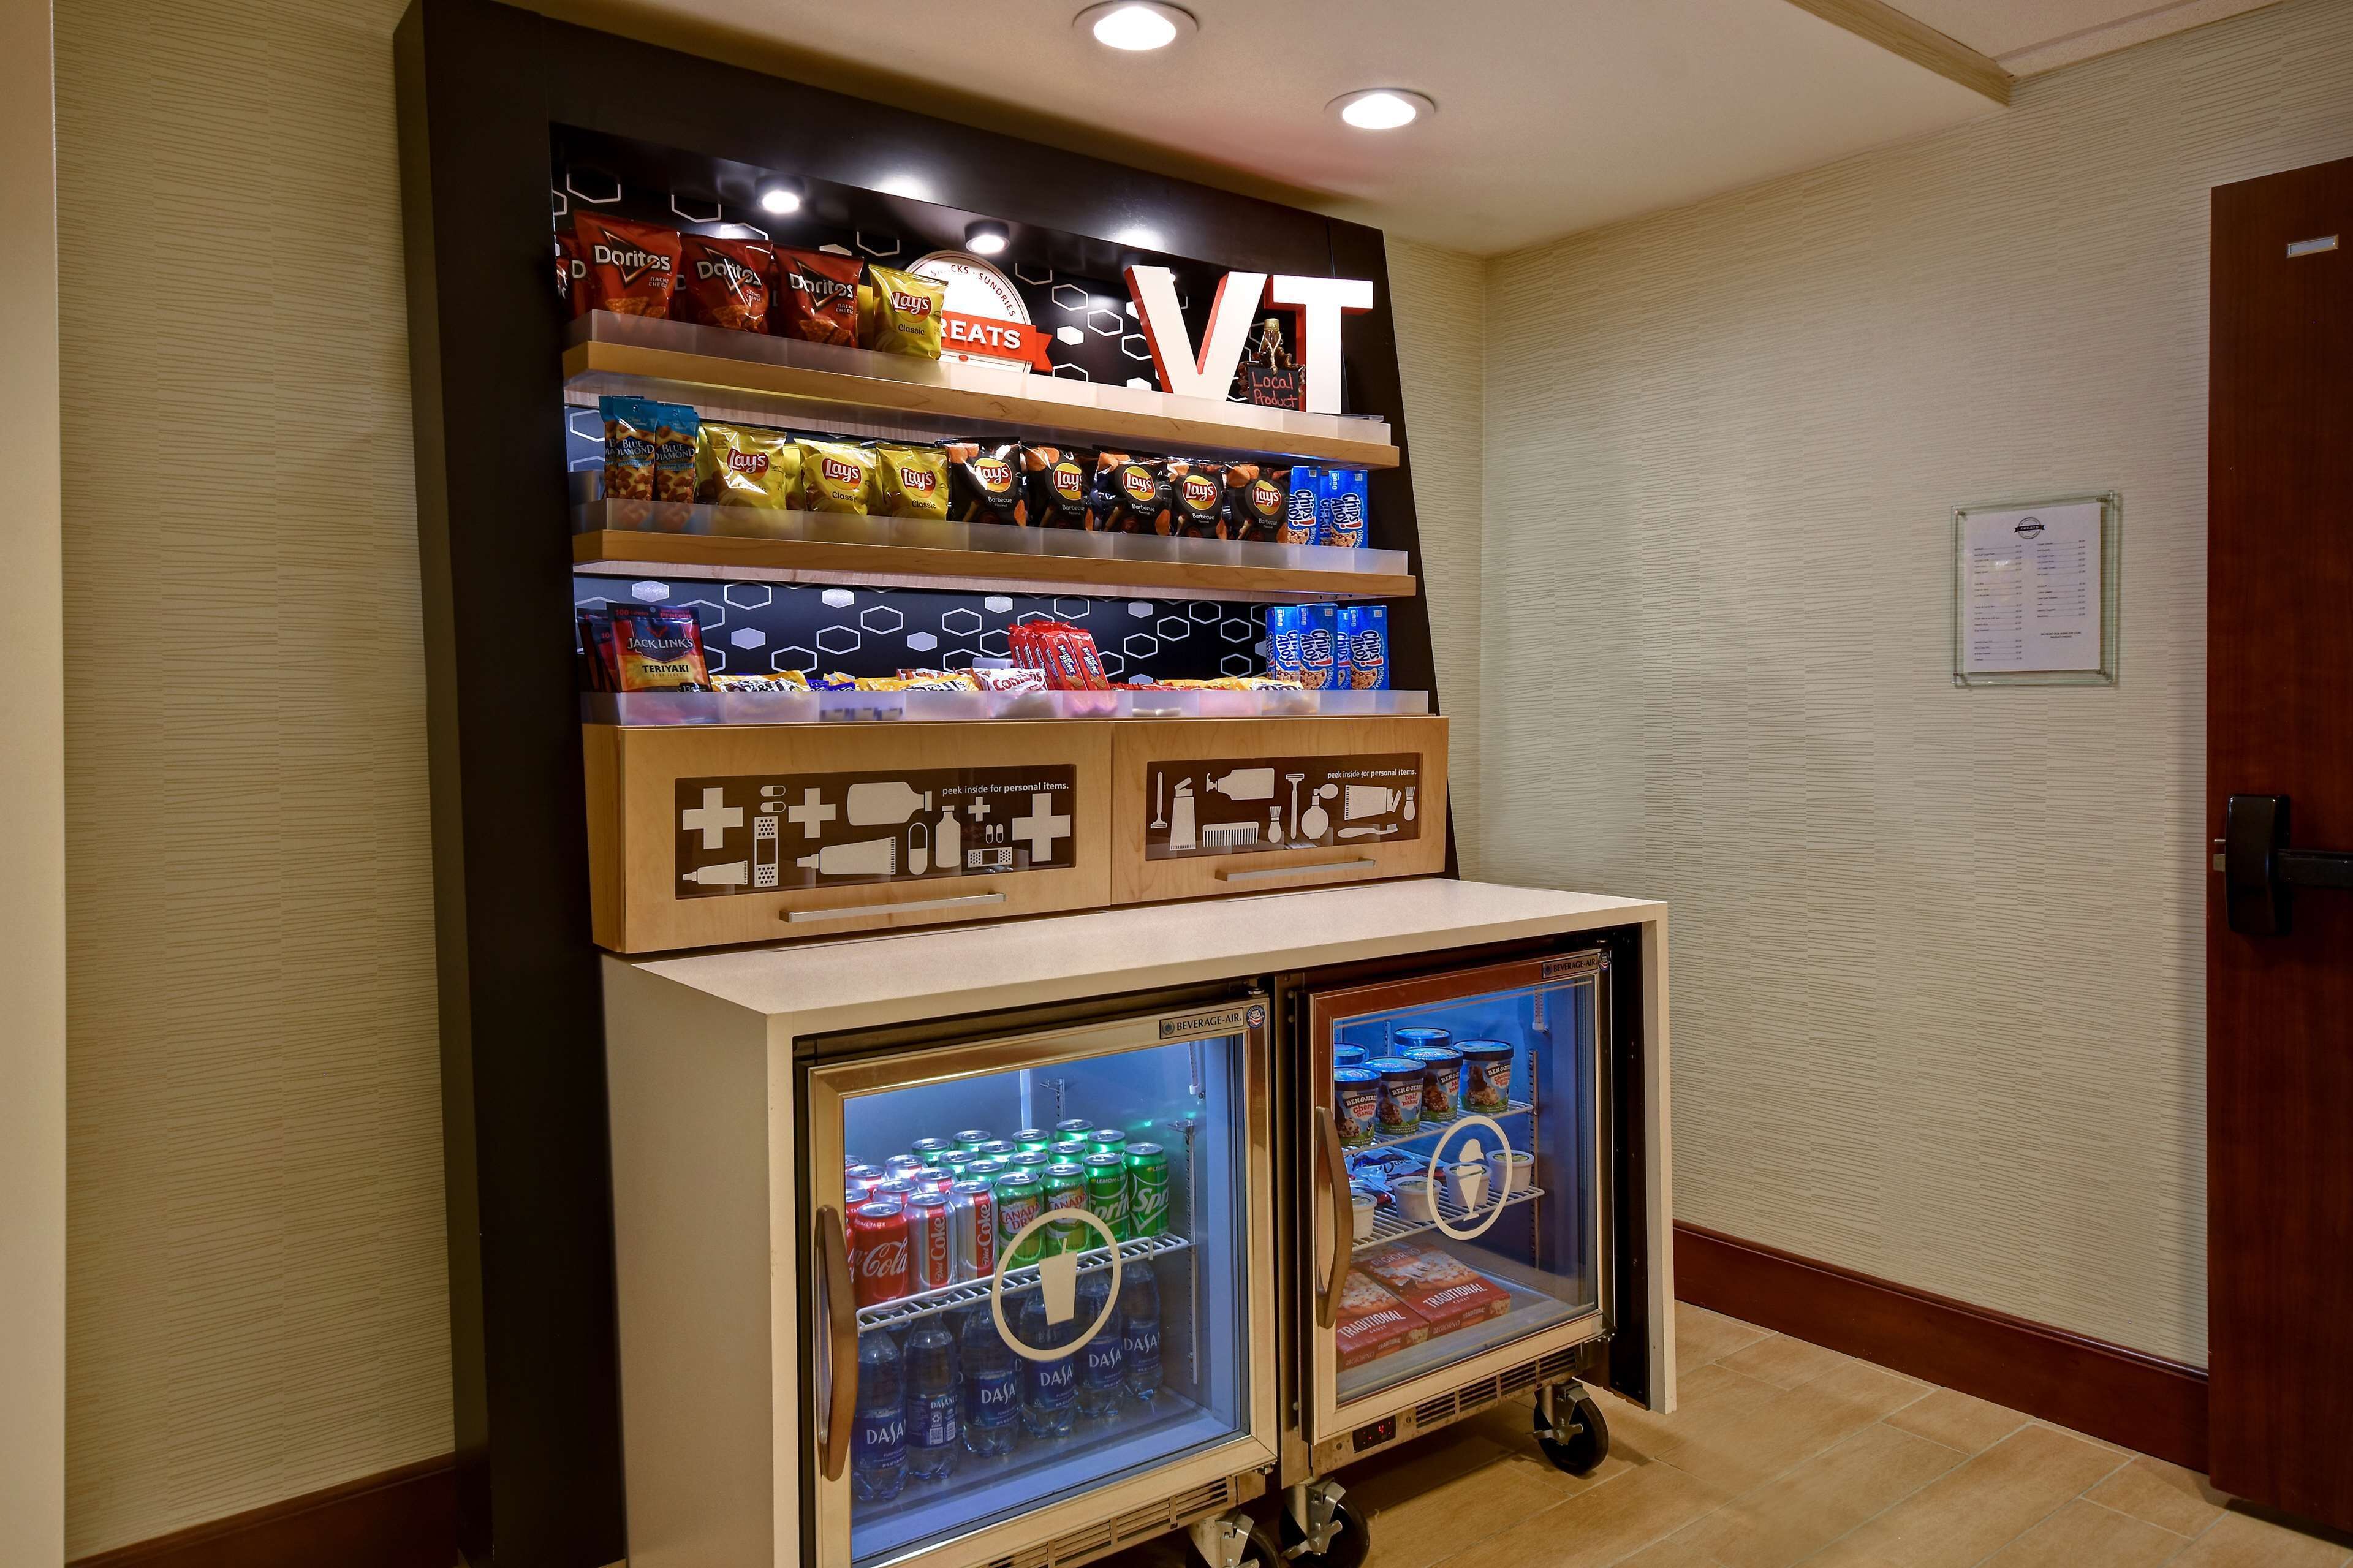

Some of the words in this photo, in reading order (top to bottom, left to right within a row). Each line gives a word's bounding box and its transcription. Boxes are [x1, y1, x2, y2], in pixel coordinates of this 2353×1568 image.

[594, 245, 671, 270] Doritos
[697, 261, 762, 287] Doritos
[790, 273, 854, 298] Doritos
[979, 273, 1016, 317] SUNDRIES
[893, 292, 930, 315] Lay's
[898, 324, 925, 335] Classic
[1124, 265, 1374, 414] VT
[1252, 371, 1294, 390] Local
[1254, 388, 1298, 407] Product
[623, 439, 643, 449] BLUE
[662, 444, 684, 453] BLUE
[729, 449, 765, 472] Lay's
[825, 460, 859, 482] Lay's
[904, 469, 933, 491] Lay's
[1127, 473, 1153, 493] Lay's
[1186, 482, 1214, 501] Lay's
[1256, 487, 1279, 506] Lay's
[912, 499, 936, 509] Classic
[1132, 503, 1155, 512] Barbecue
[1295, 490, 1314, 519] Chips
[1341, 493, 1361, 522] Chips
[627, 638, 659, 650] JACK
[658, 638, 694, 648] LINK'S
[1311, 629, 1330, 659] Chips
[1362, 630, 1381, 660] Chips
[1058, 645, 1075, 665] Nutter
[1059, 655, 1077, 675] Butter
[1082, 646, 1099, 667] Nutter
[1083, 656, 1101, 675] Butter
[1327, 771, 1342, 779] peek
[1370, 769, 1397, 778] personal
[942, 786, 963, 797] peek
[964, 785, 988, 794] inside
[990, 784, 1002, 793] for
[1004, 782, 1041, 793] personal
[999, 1202, 1040, 1224] CANADA
[1011, 1215, 1034, 1230] DRY
[977, 1203, 992, 1246] Coke
[930, 1216, 946, 1261] Coke
[1423, 1282, 1488, 1308] TRADITIONAL
[1337, 1309, 1406, 1338] TRADITIONAL
[931, 1397, 956, 1409] DASANI
